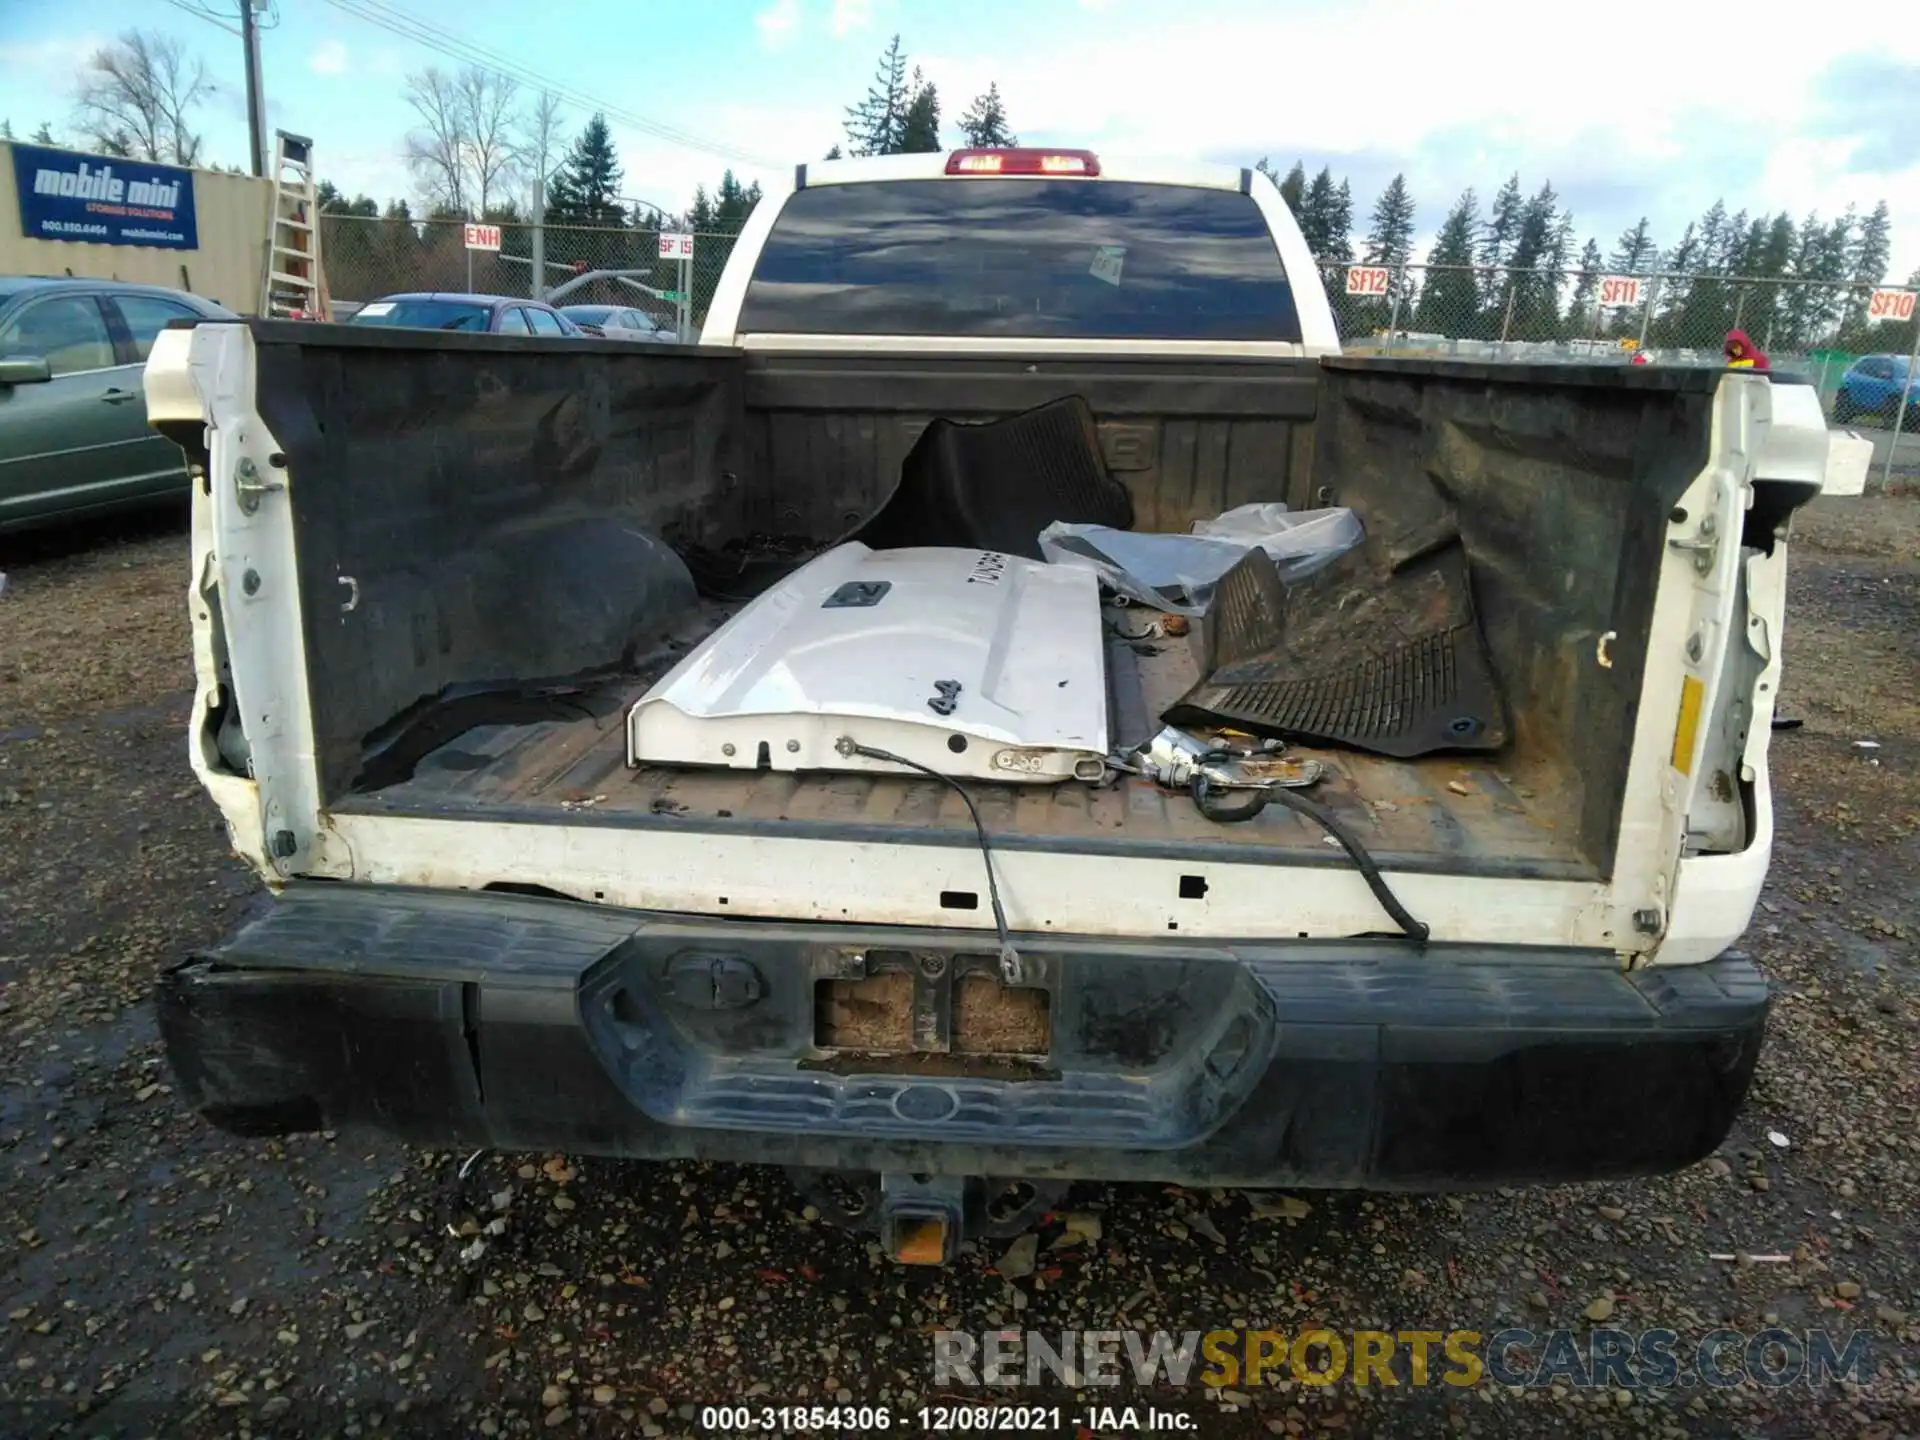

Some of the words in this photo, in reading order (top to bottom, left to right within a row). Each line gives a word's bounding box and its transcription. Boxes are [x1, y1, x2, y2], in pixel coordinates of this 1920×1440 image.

[34, 162, 124, 202] mobile
[127, 177, 180, 208] mini
[466, 227, 498, 246] ENH
[1349, 269, 1386, 292] SF12
[1601, 279, 1637, 303] SF11
[1871, 292, 1913, 317] SF10
